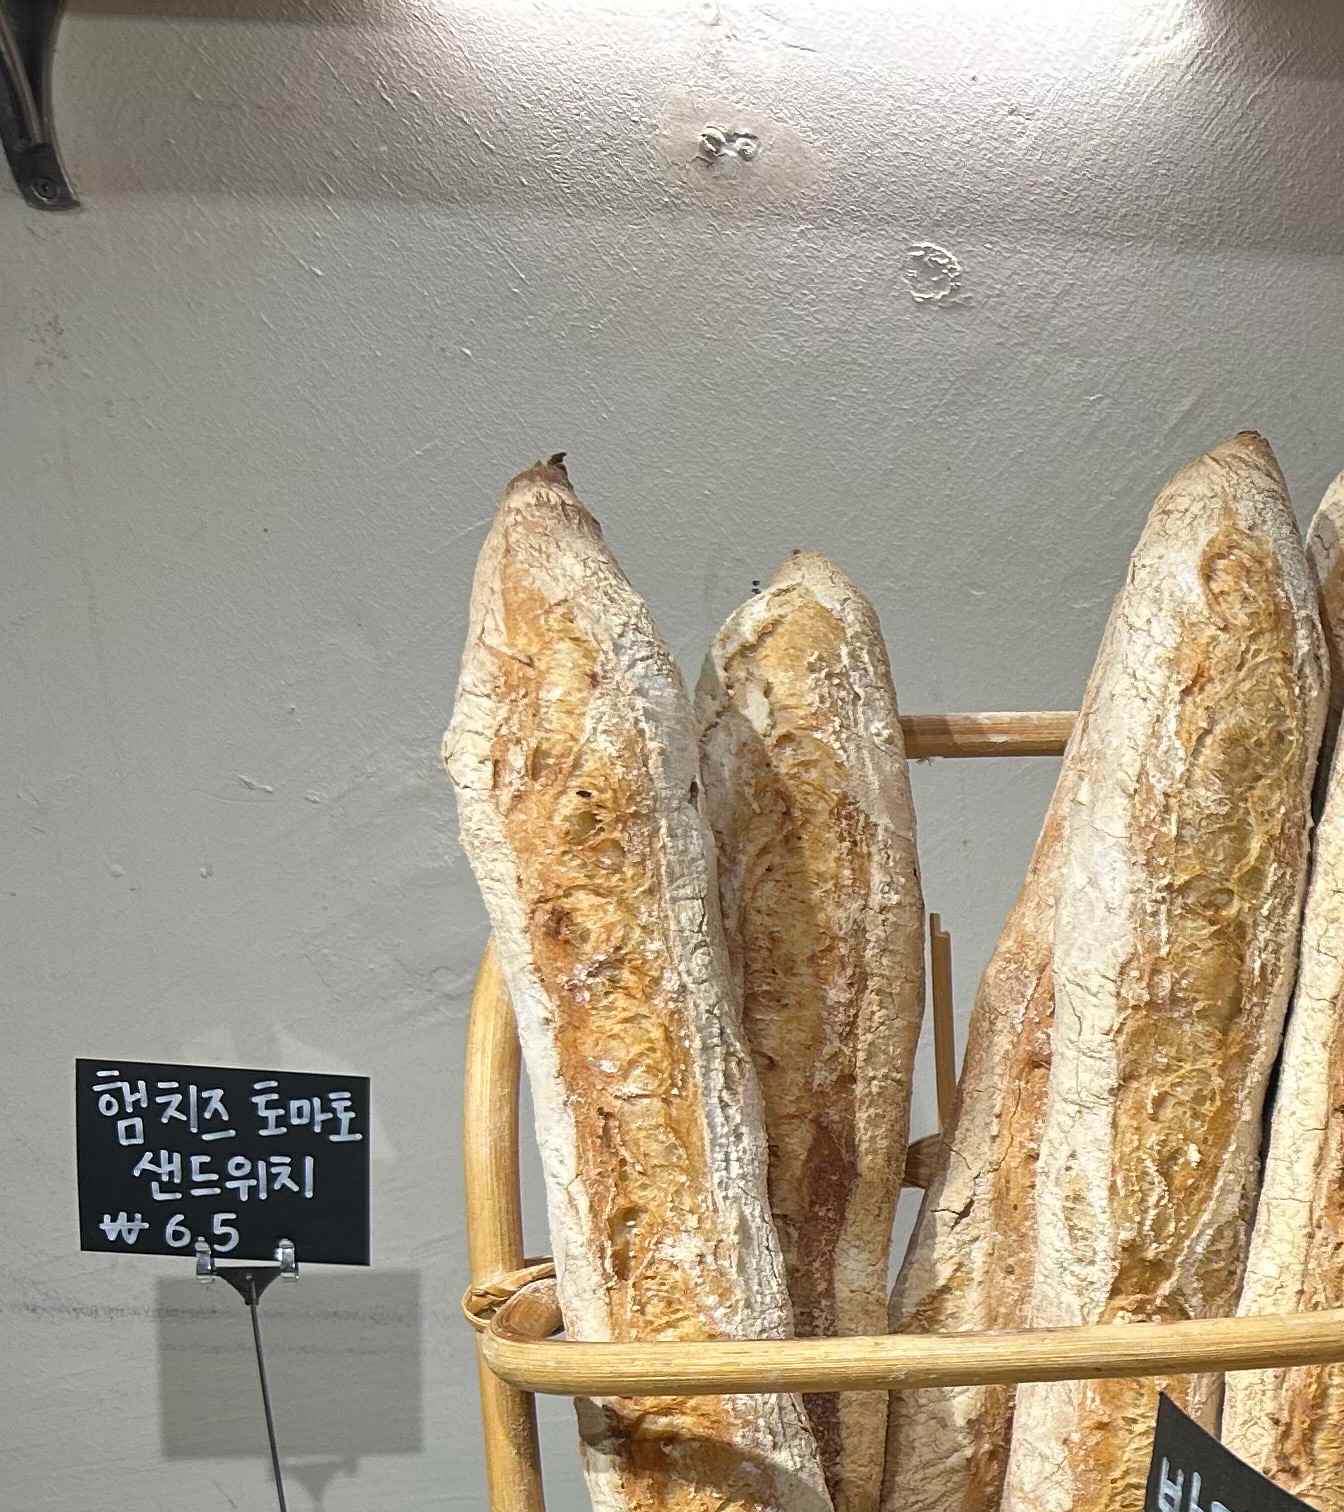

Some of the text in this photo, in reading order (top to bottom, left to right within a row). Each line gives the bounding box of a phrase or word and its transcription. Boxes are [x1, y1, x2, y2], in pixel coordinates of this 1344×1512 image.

[92, 1070, 363, 1146] 햄치즈 토마토
[133, 1149, 315, 1201] 샌드위치
